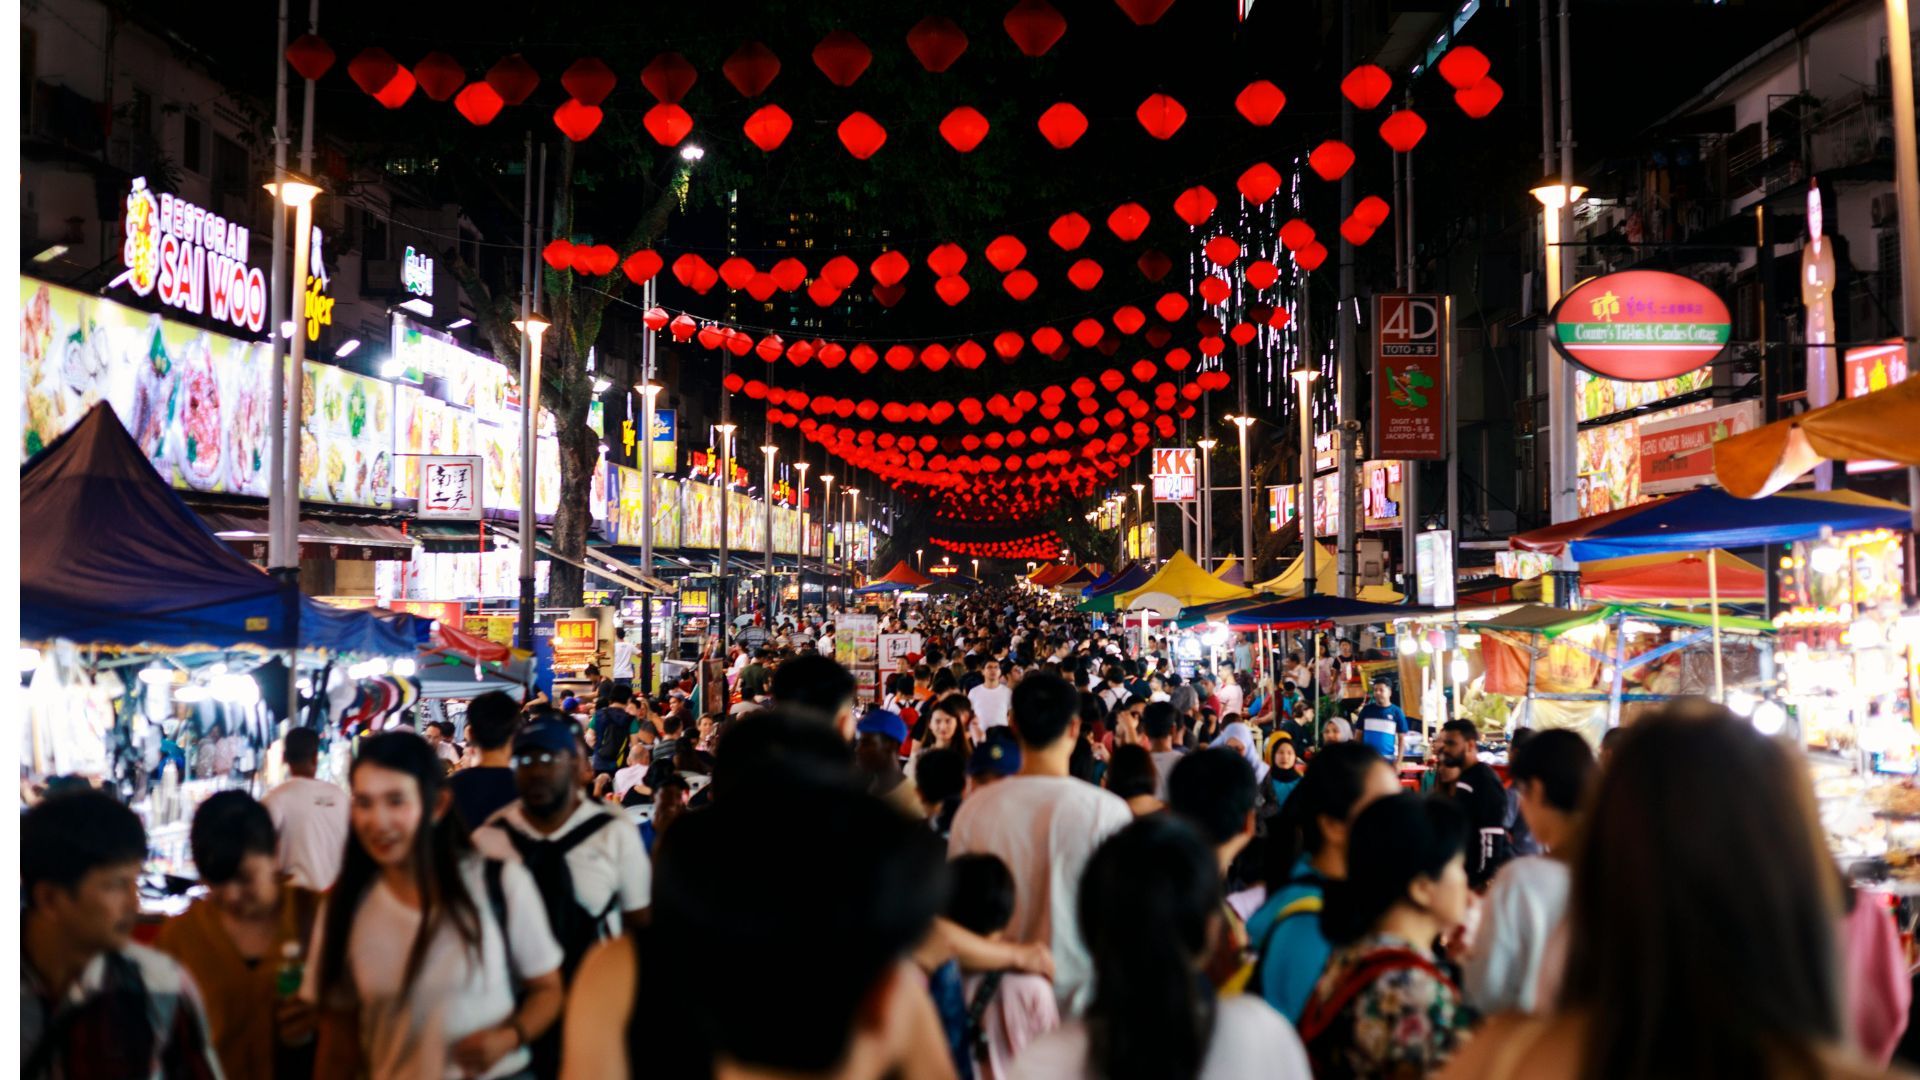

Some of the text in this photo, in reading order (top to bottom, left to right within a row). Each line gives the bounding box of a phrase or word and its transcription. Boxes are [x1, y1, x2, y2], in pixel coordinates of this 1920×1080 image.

[161, 193, 249, 263] RESTORAN
[158, 233, 205, 314] SAI
[207, 251, 267, 332] WOO
[305, 275, 335, 341] iger
[1383, 301, 1438, 339] 4D
[1385, 345, 1411, 354] TOTO
[432, 465, 468, 489] 南洋
[1157, 450, 1191, 474] KK
[1169, 476, 1181, 499] 24
